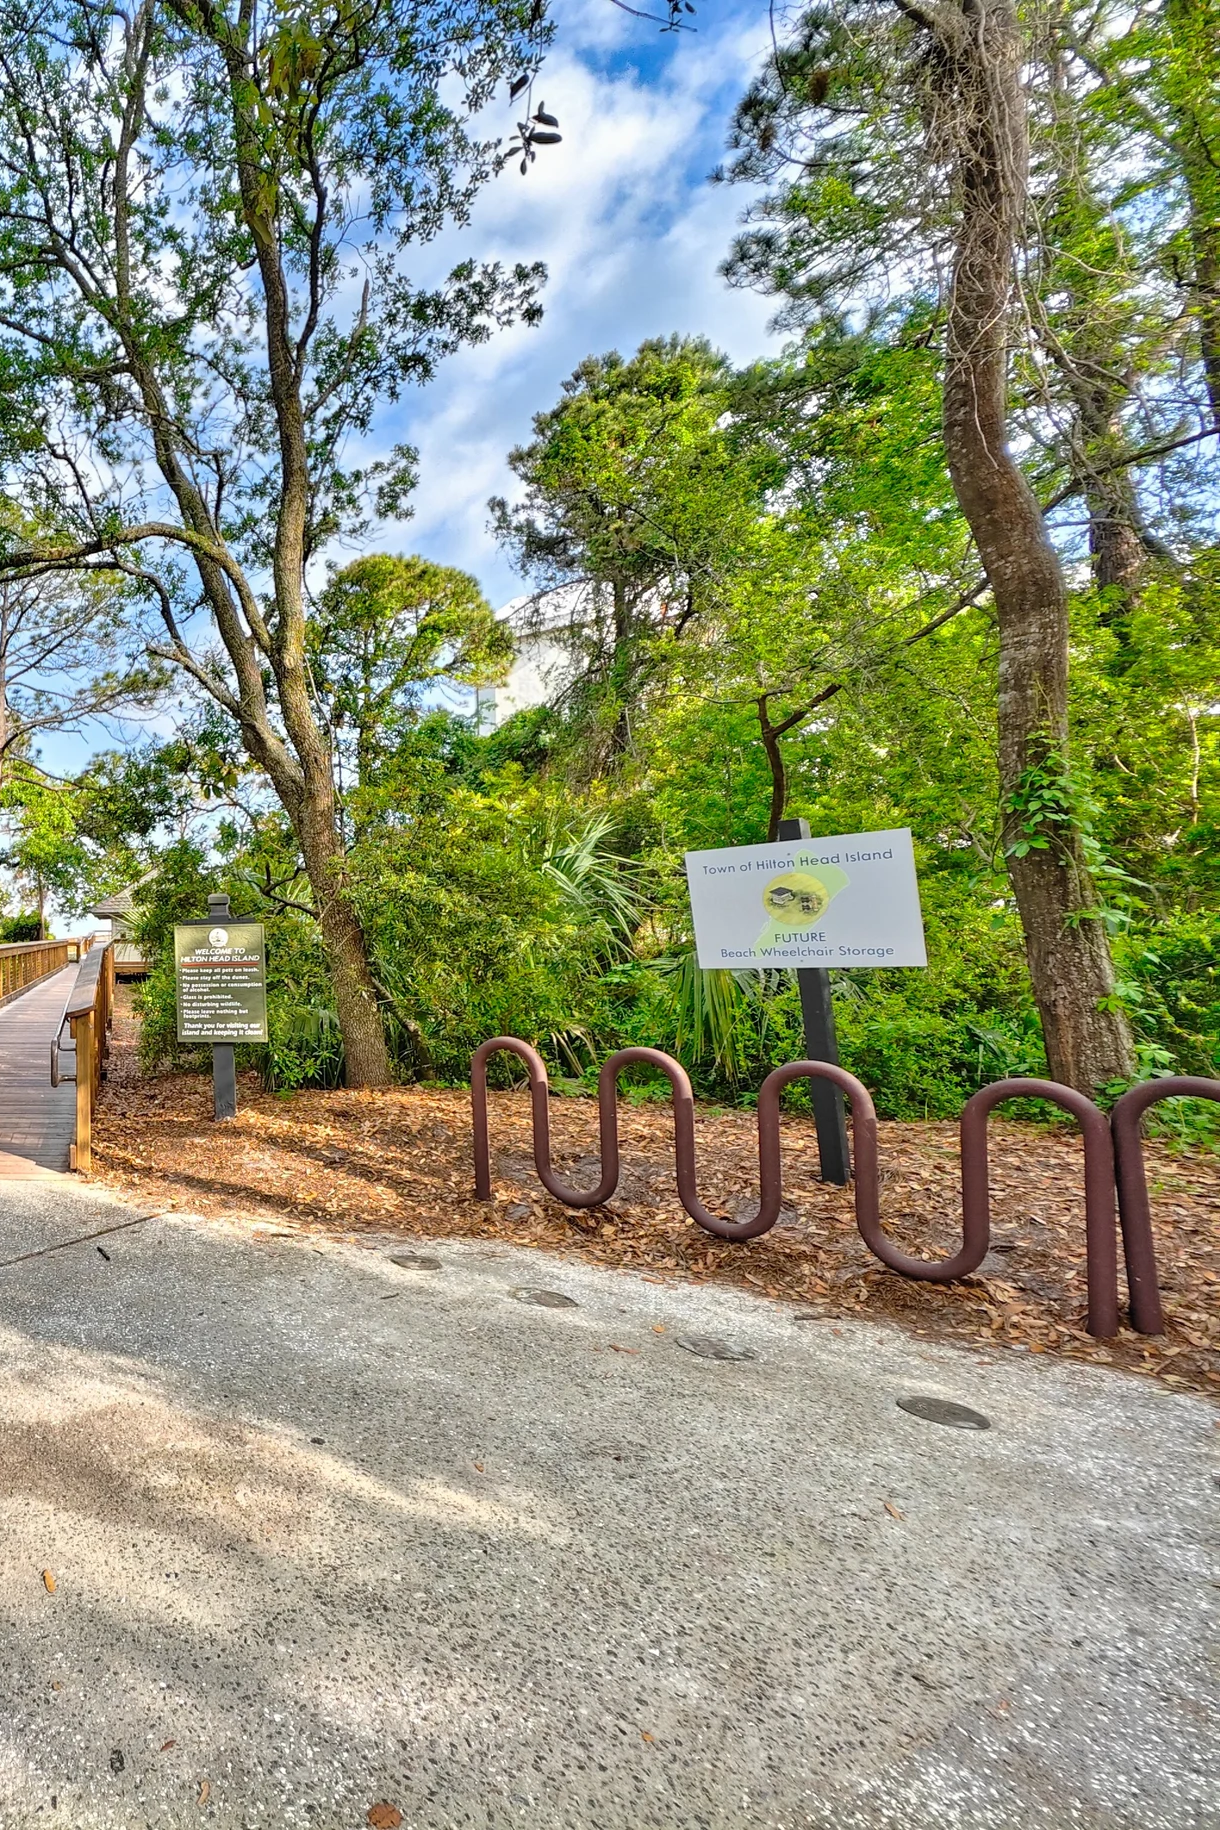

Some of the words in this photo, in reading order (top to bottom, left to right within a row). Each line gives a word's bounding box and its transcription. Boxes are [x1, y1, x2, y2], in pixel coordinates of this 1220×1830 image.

[703, 864, 735, 875] Town
[740, 862, 752, 872] of
[757, 858, 795, 870] Hilton
[800, 853, 840, 866] Head
[846, 848, 893, 862] Island
[775, 932, 826, 943] FUTURE
[721, 948, 756, 958] Beach
[760, 946, 834, 957] Wheelchair
[839, 946, 894, 958] Storage
